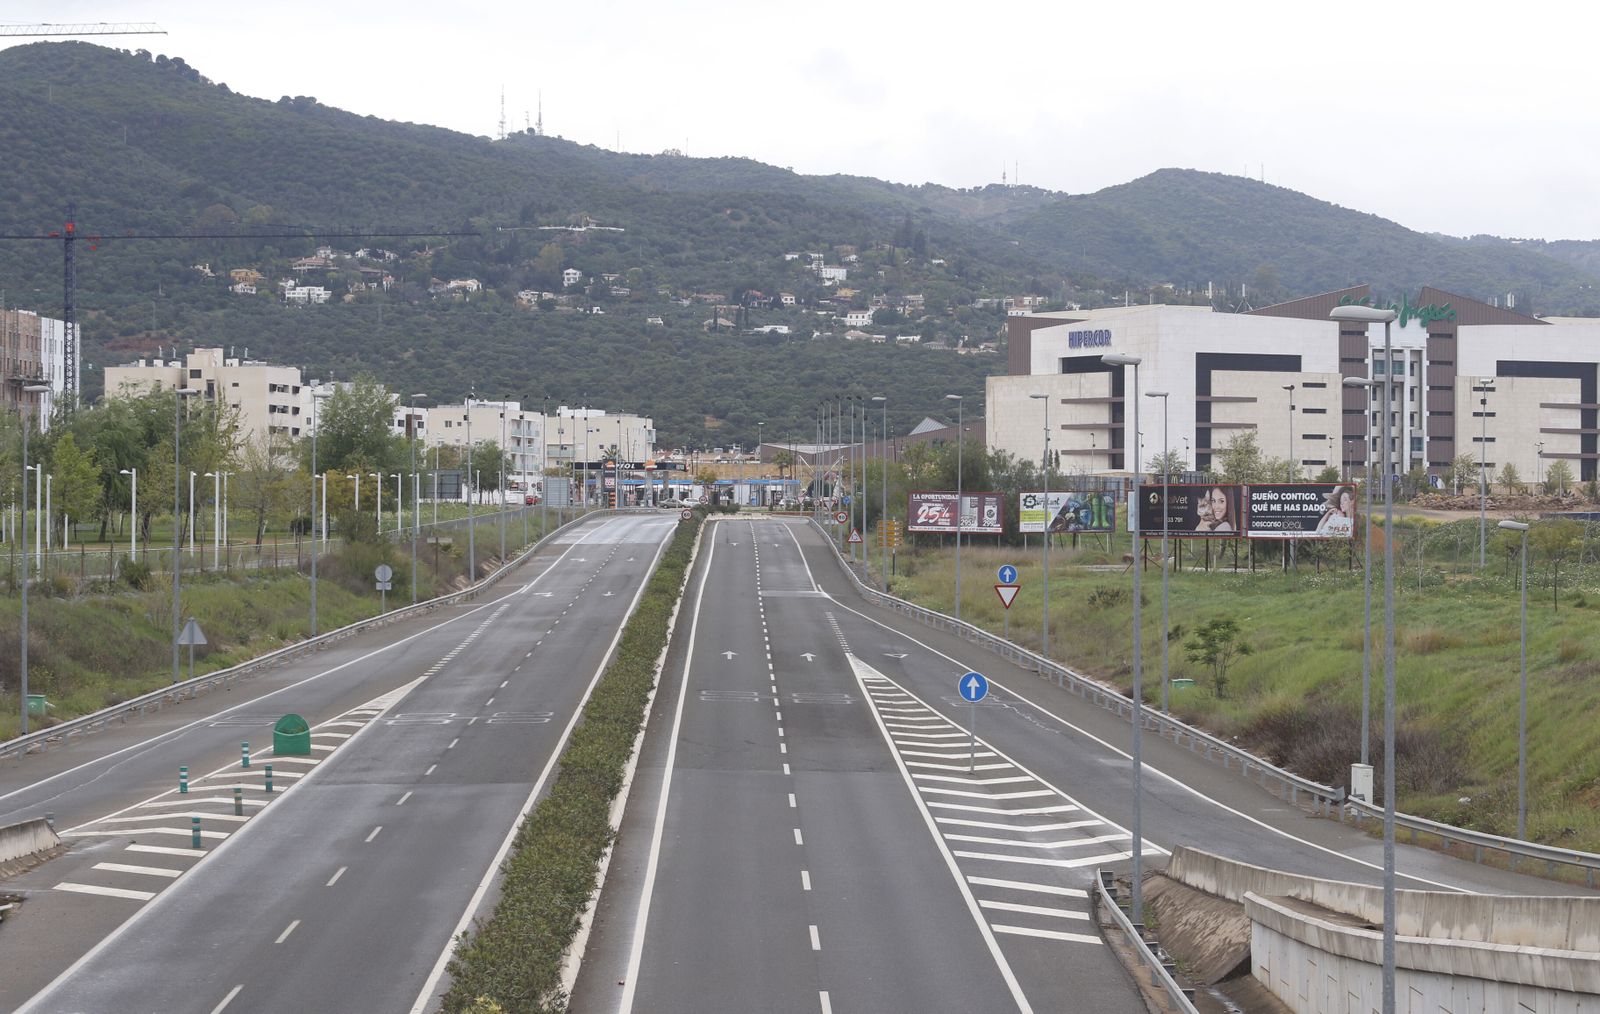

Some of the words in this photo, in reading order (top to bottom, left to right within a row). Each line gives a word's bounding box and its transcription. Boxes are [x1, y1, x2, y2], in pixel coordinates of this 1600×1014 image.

[1068, 329, 1112, 349] HIPERCOR
[1251, 490, 1279, 501] SUEÑO
[1280, 492, 1318, 502] CONTIGO,
[1251, 502, 1268, 513] QUÉ
[1270, 503, 1282, 512] ME
[1284, 502, 1301, 513] HAS
[1302, 503, 1328, 512] DADO.
